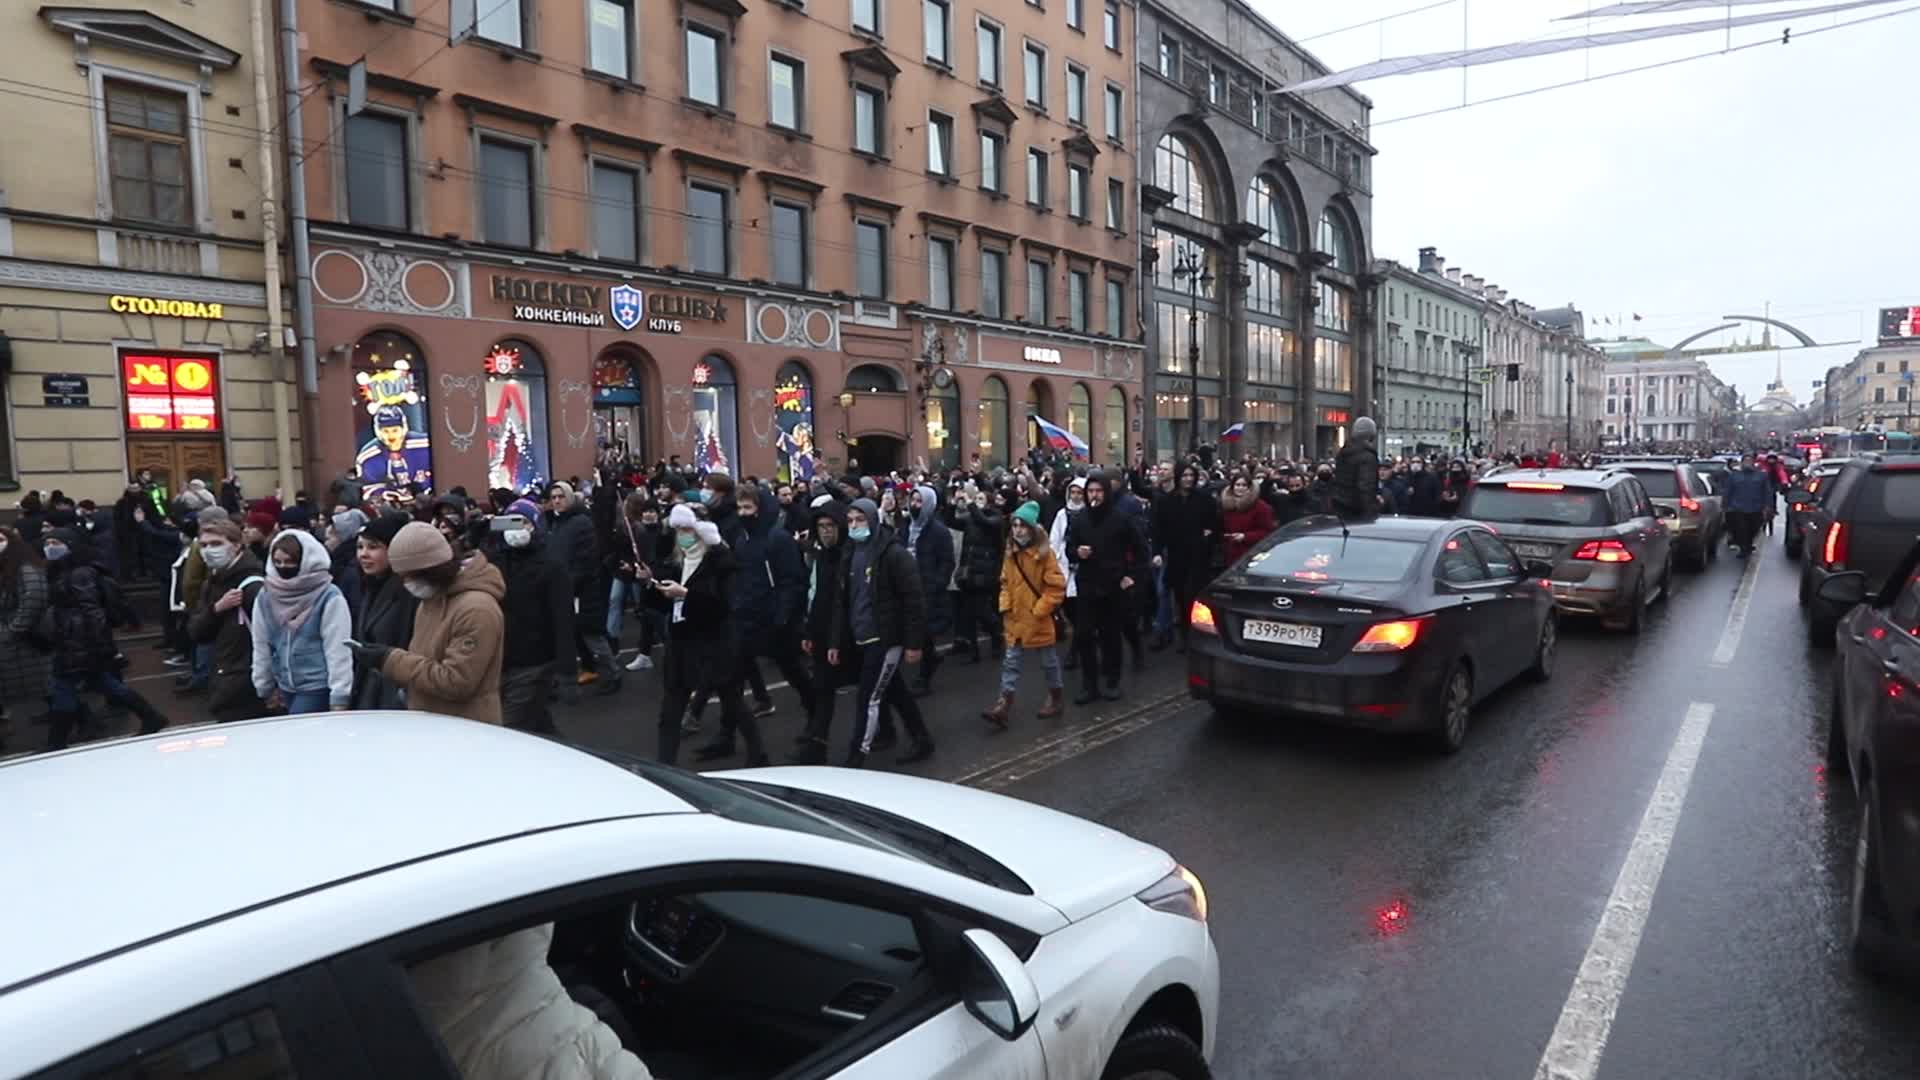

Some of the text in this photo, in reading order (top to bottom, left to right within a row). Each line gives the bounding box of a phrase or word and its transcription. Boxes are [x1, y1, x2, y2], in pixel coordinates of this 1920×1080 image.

[110, 295, 223, 319] СТОЛОВАЯ
[514, 304, 682, 333] ХОККЕЙНЫЙ КЛУБ
[1024, 345, 1062, 364] IKEA
